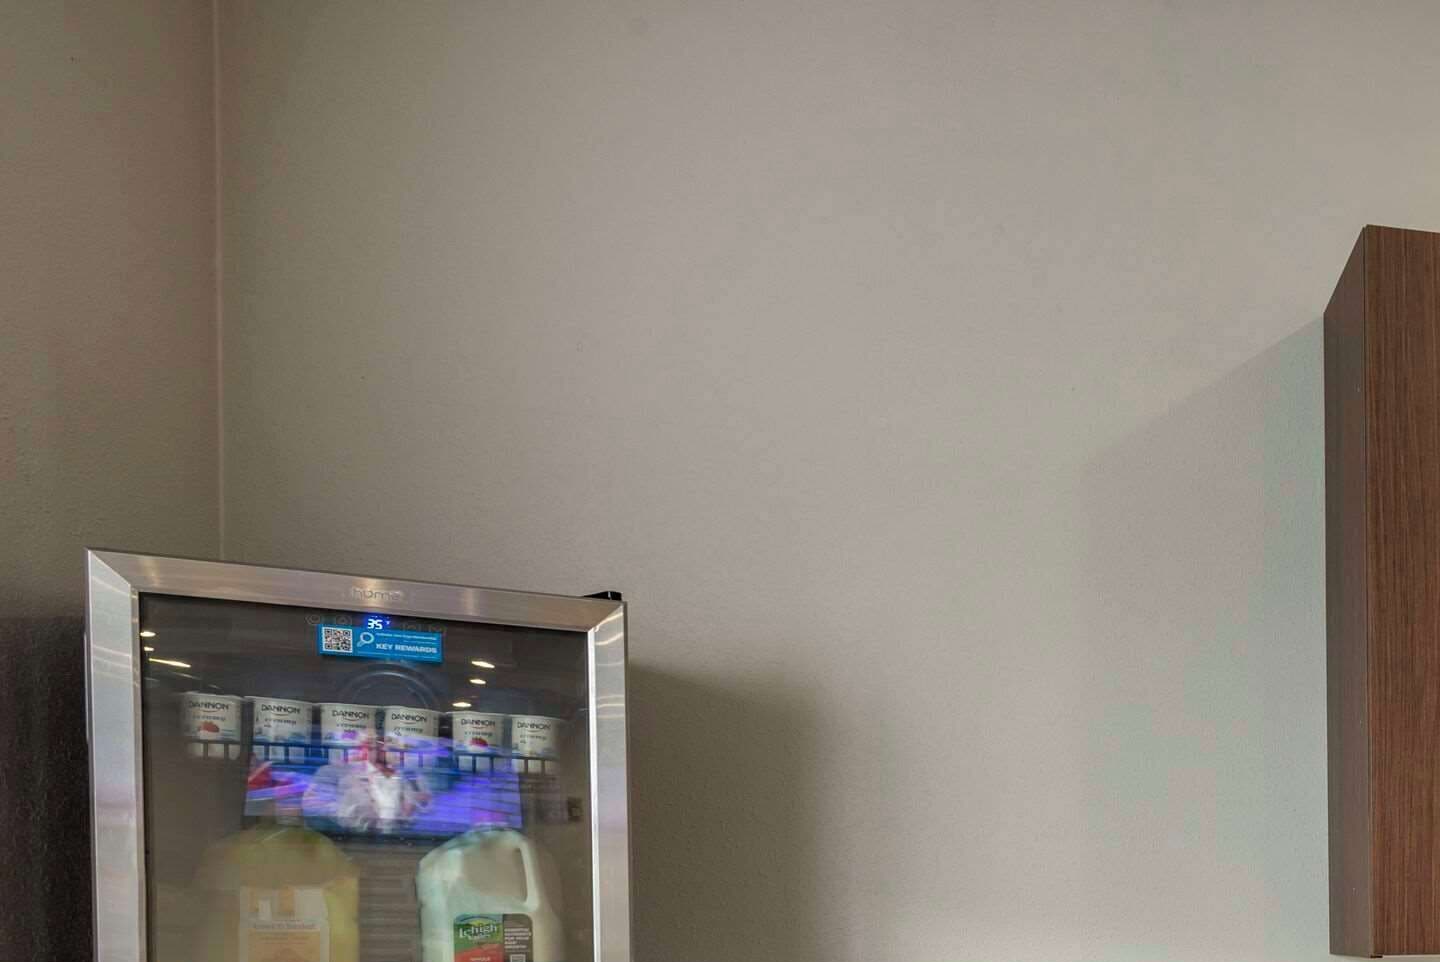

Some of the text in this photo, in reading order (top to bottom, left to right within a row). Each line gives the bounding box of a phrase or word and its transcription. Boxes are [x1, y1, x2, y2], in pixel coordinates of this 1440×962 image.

[367, 618, 383, 630] 35
[395, 645, 438, 653] REWARDS
[189, 701, 229, 711] DANNON
[261, 704, 300, 714] DANNON
[332, 709, 369, 719] DANNON
[391, 712, 428, 722] DANNON
[461, 717, 496, 727] DANNON
[517, 720, 551, 730] DANNON
